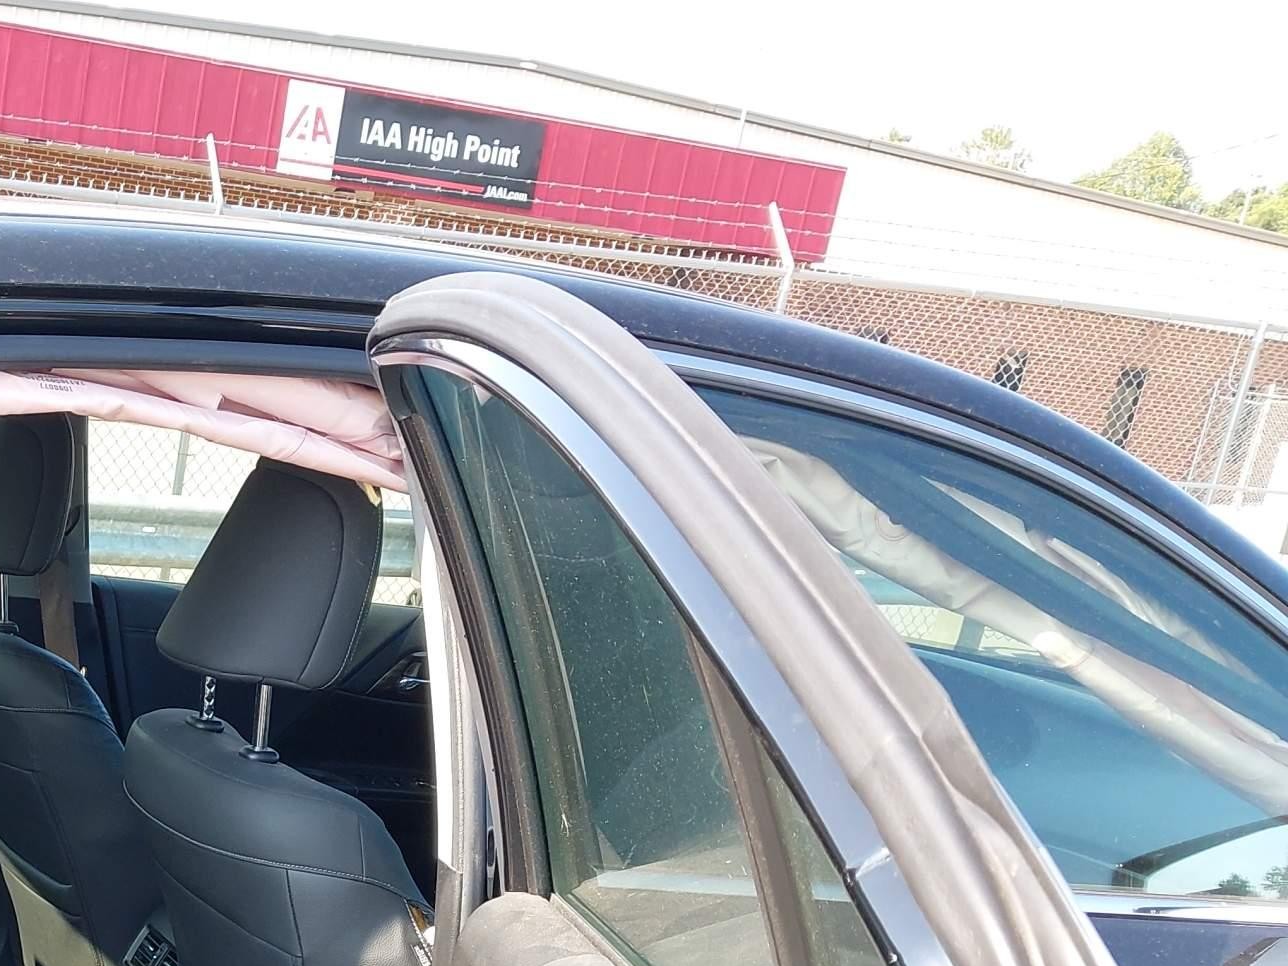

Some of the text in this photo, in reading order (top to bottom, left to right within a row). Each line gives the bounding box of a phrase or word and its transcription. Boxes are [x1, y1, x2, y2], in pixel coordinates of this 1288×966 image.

[359, 117, 521, 168] IAA High Point
